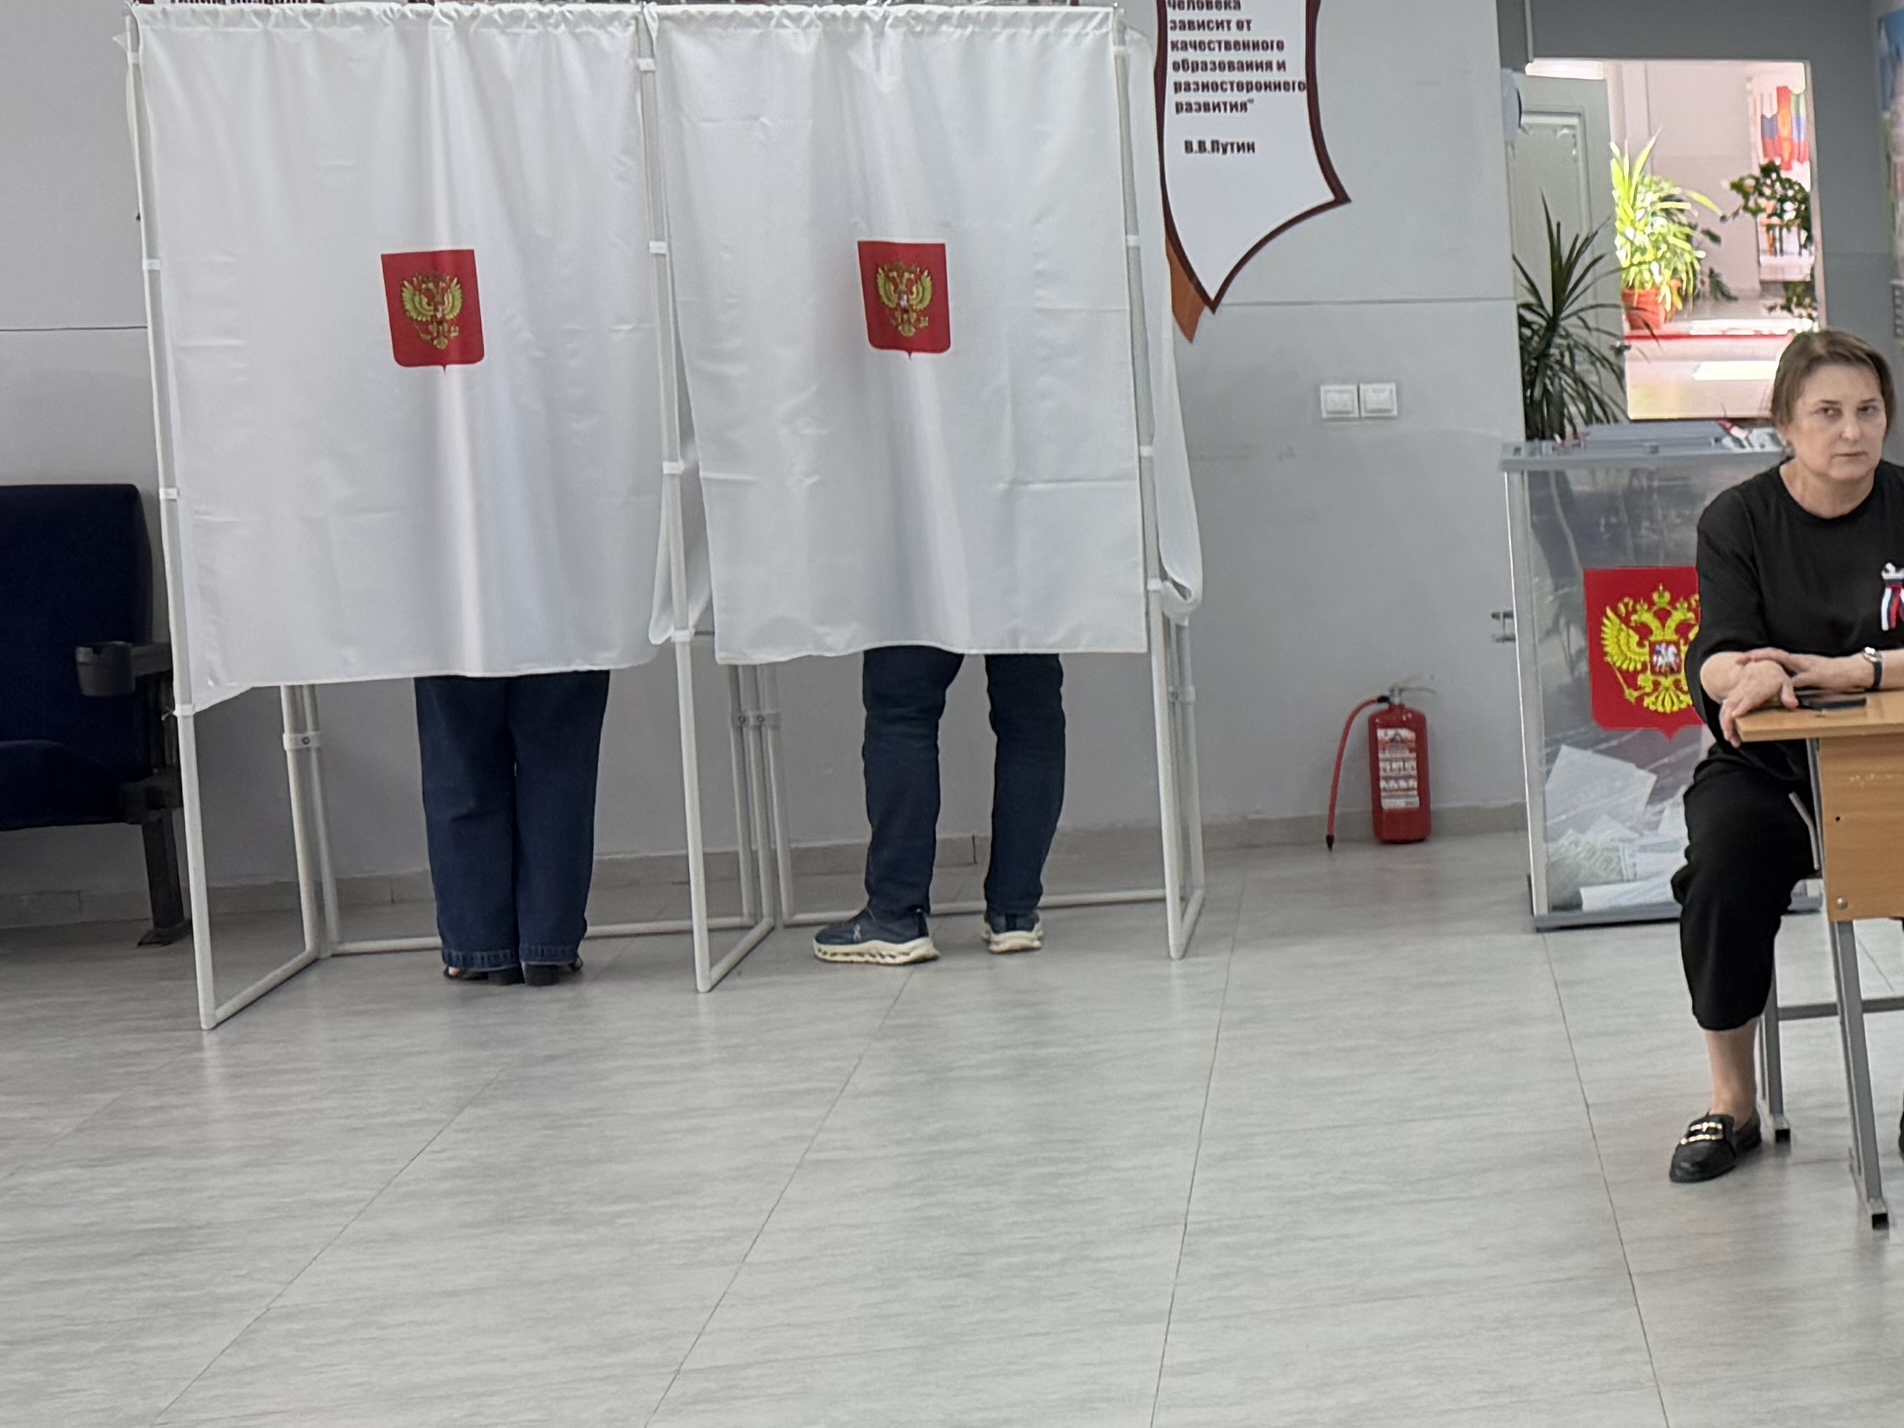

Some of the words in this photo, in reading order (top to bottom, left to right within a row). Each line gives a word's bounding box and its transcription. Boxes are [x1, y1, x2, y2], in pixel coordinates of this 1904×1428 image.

[1169, 18, 1232, 32] зависит
[1236, 19, 1253, 32] от
[1170, 39, 1285, 53] качественного
[1172, 59, 1274, 74] образования
[1276, 60, 1287, 72] и
